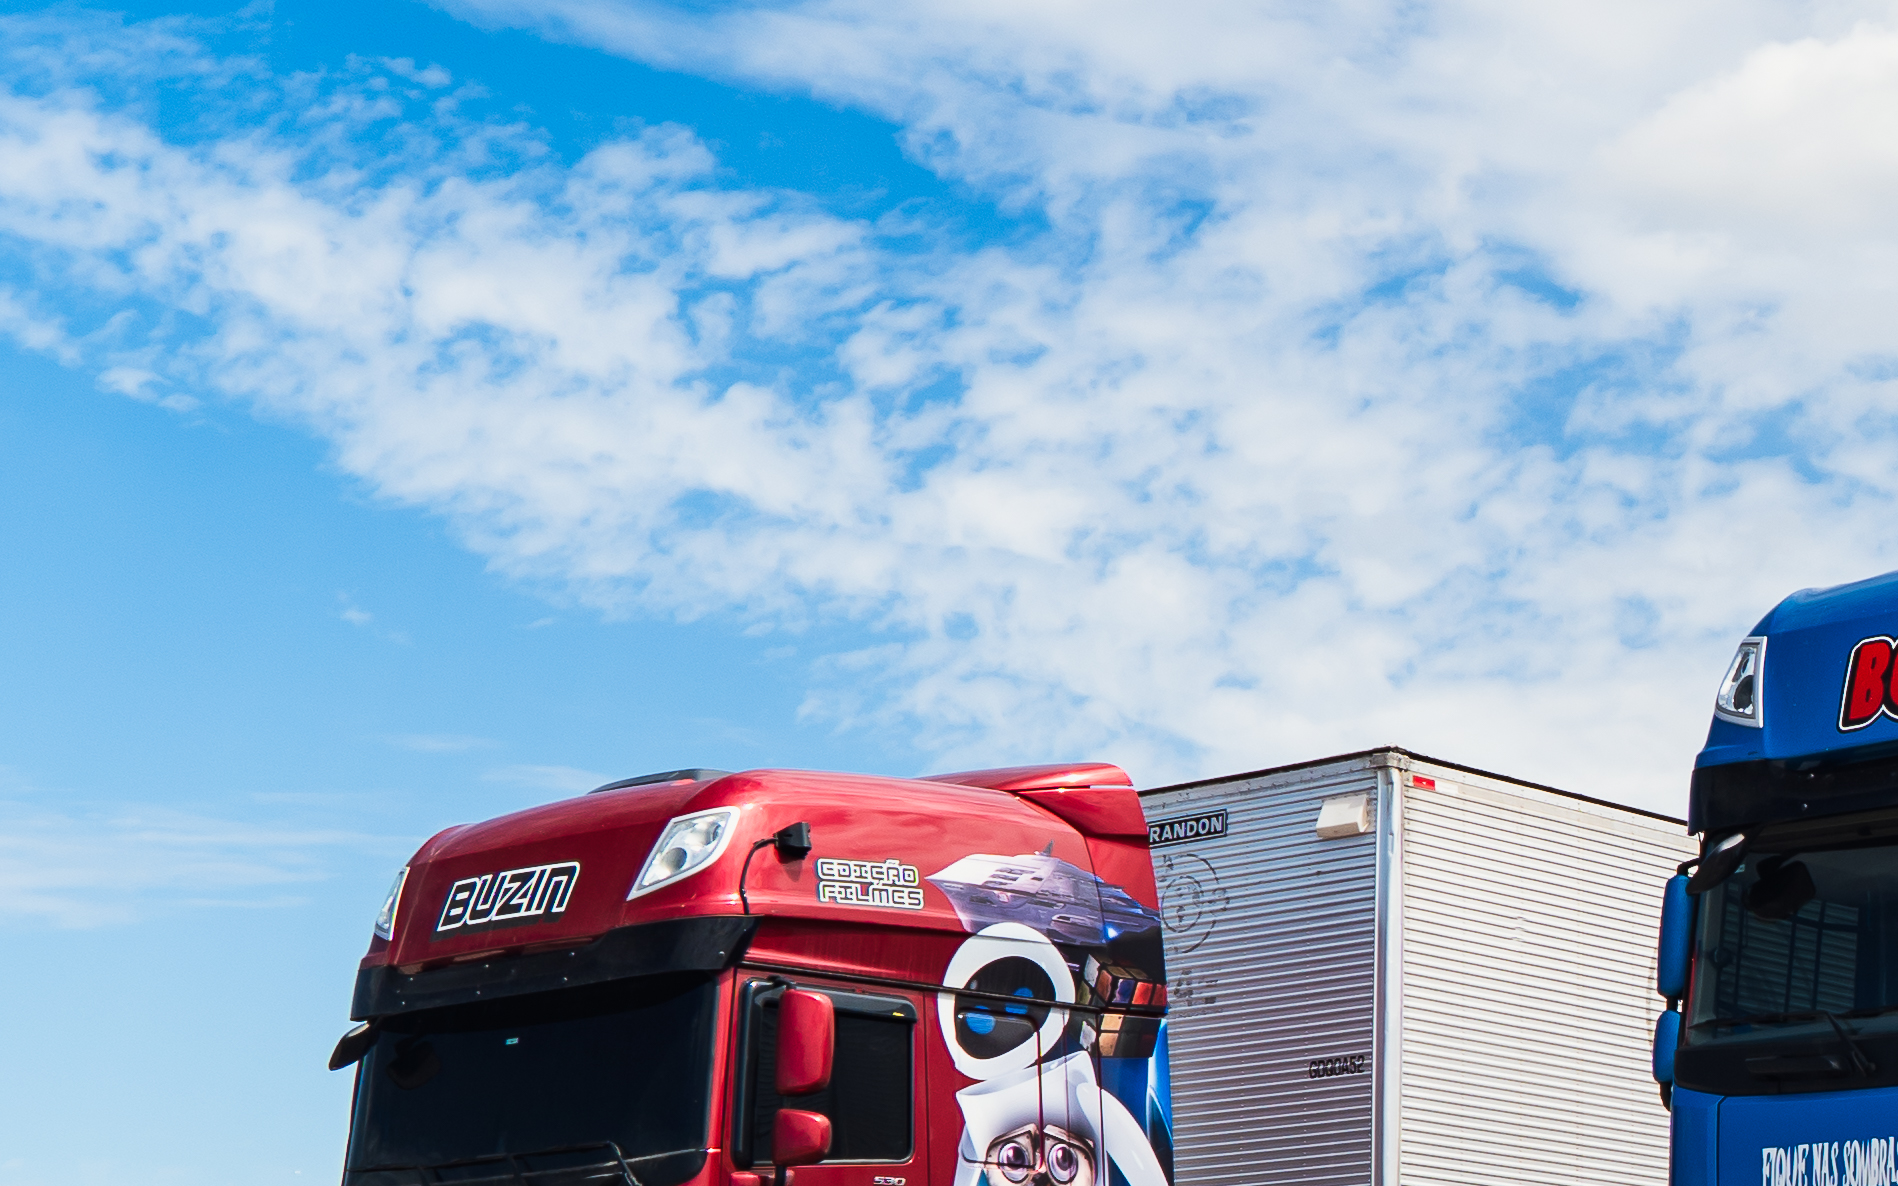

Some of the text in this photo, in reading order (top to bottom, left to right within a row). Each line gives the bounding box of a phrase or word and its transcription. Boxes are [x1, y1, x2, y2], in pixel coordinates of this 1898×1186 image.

[1150, 815, 1223, 844] RANDON
[436, 861, 580, 933] BUZIN
[819, 880, 924, 909] FILMES
